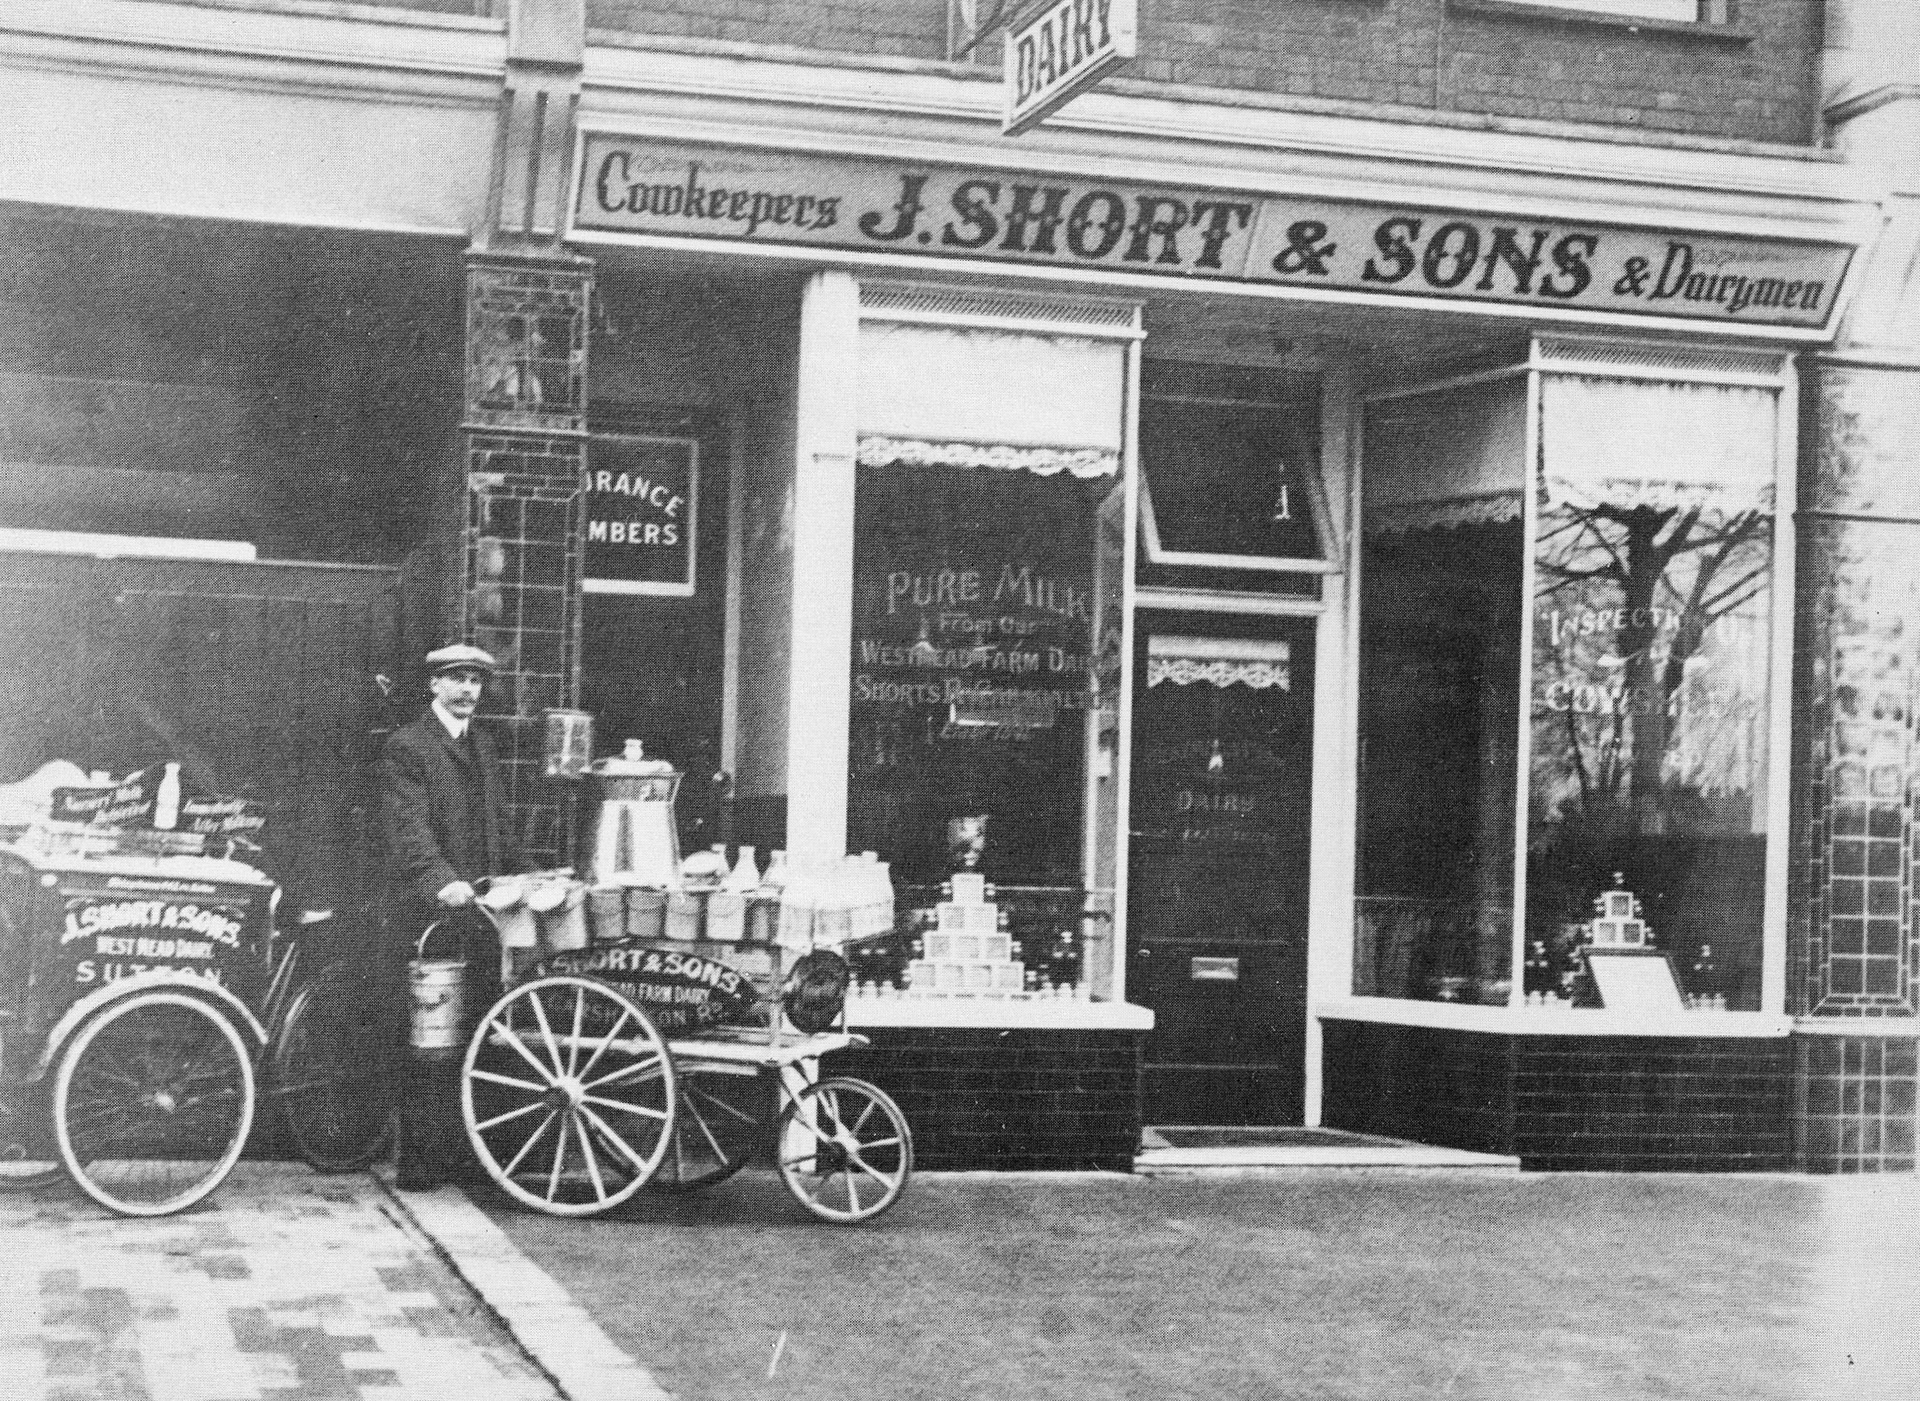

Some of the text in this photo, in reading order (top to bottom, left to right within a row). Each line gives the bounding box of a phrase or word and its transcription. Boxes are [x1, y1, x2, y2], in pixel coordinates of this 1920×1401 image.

[1016, 0, 1112, 107] DAIRY
[596, 149, 842, 235] Cowkeepers
[1271, 219, 1338, 276] &
[1360, 216, 1599, 299] SONS
[887, 569, 980, 615] PURE
[1552, 606, 1690, 648] INSPECTI
